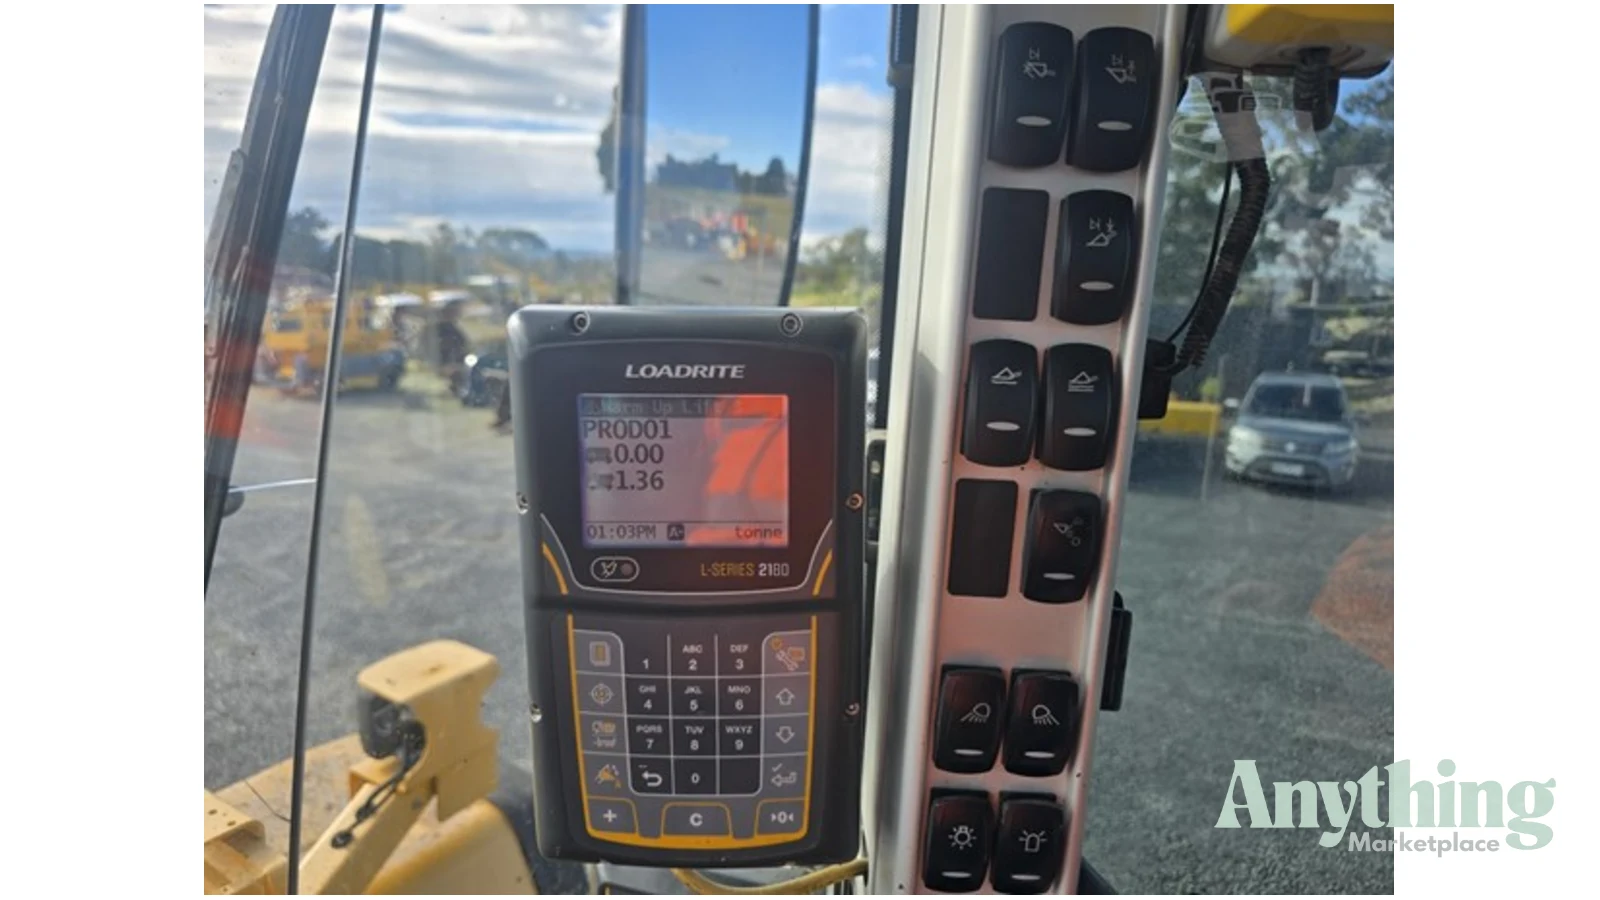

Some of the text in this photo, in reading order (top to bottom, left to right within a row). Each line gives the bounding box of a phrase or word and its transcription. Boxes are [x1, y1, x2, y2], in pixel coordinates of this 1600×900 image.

[624, 364, 746, 379] LOADRITE
[614, 444, 664, 464] 0.00
[616, 470, 665, 491] 1.36
[587, 525, 657, 540] 01:03PM
[734, 525, 783, 539] tonne
[700, 563, 755, 577] L-SERIES
[682, 644, 703, 654] ABC
[730, 643, 749, 653] DEF
[642, 659, 649, 670] 1
[688, 659, 697, 671] 2
[735, 659, 744, 670] 3
[727, 685, 751, 695] MNO
[643, 699, 652, 710] 4
[689, 700, 698, 711] 5
[735, 699, 744, 711] 6
[685, 725, 705, 735] TUV
[646, 739, 654, 749] 7
[690, 739, 699, 751] 8
[735, 739, 744, 750] 9
[691, 772, 700, 784] 0
[689, 812, 703, 827] C
